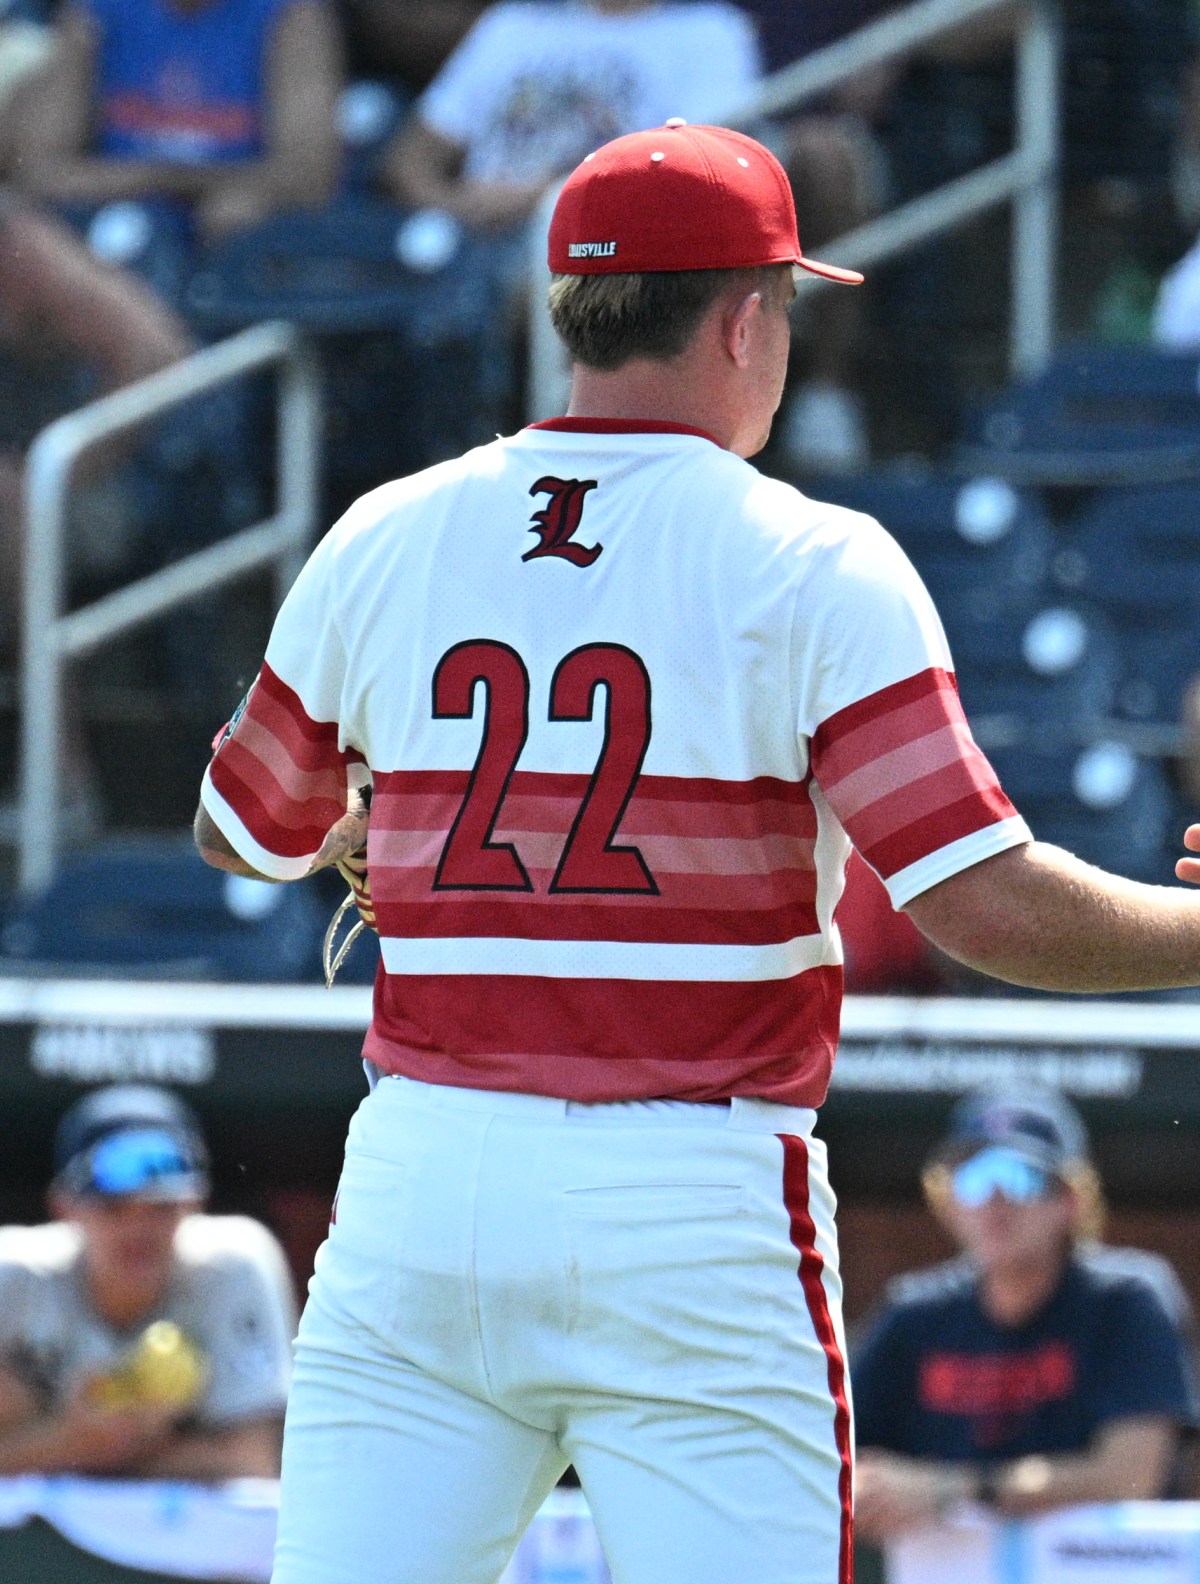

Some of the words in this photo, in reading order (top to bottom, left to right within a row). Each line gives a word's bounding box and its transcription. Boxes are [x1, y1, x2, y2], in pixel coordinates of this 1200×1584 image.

[568, 241, 617, 258] LOUISVILLE
[521, 476, 603, 568] L
[431, 638, 660, 895] 22
